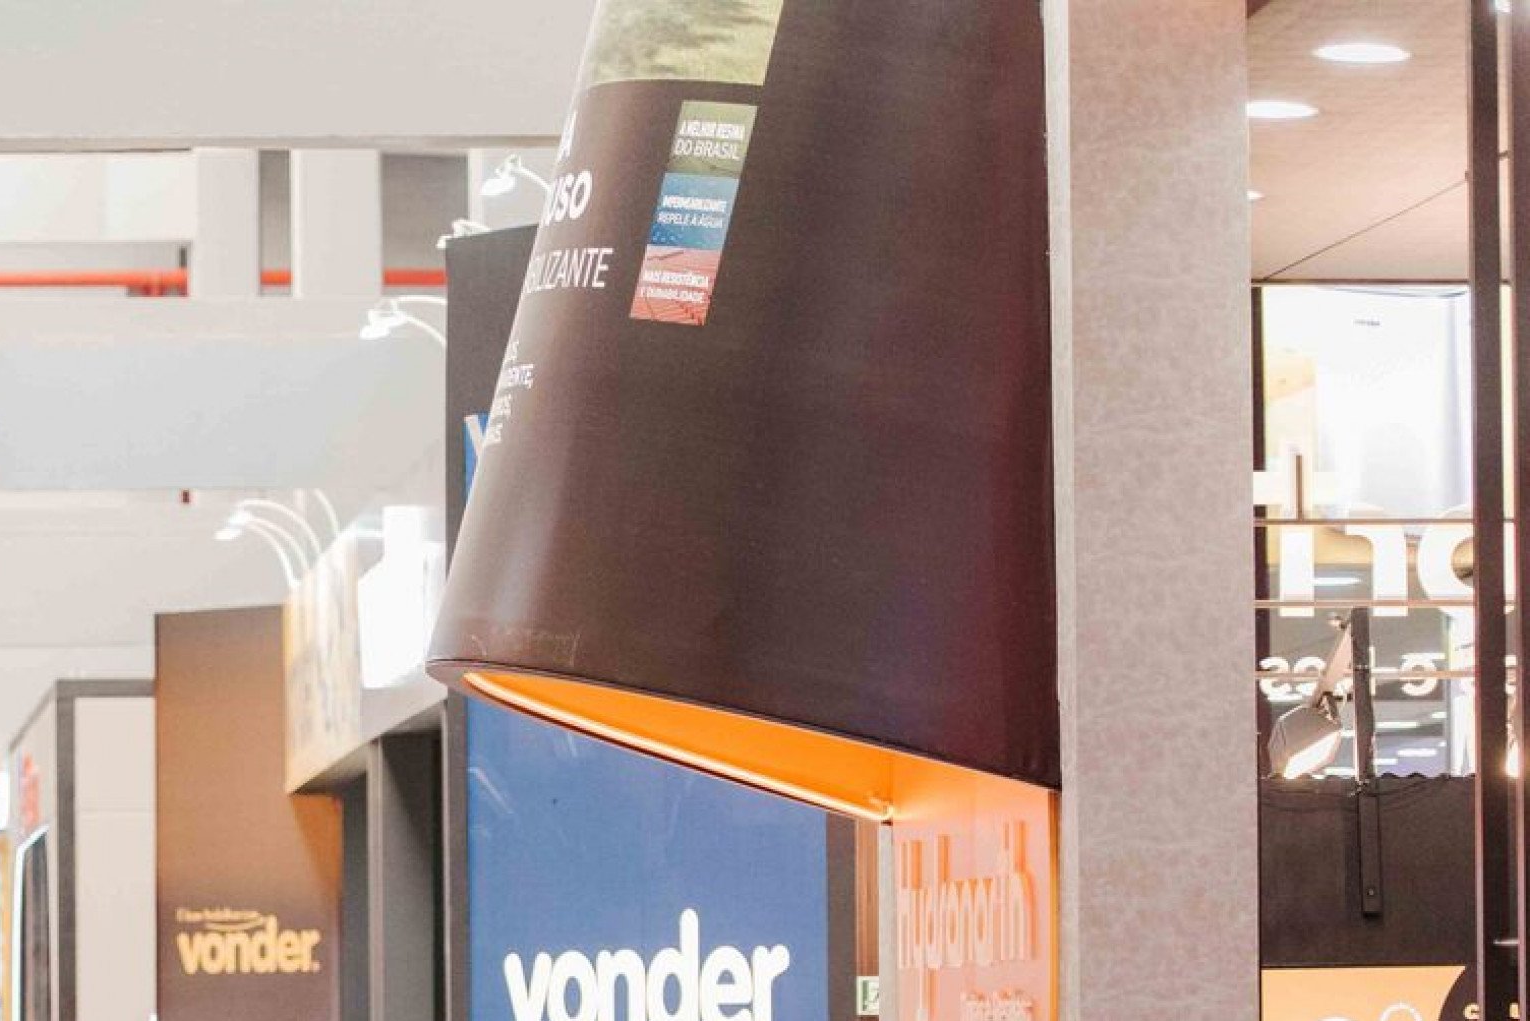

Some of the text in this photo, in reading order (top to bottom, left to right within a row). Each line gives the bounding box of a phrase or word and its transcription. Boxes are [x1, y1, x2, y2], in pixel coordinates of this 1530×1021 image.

[673, 139, 741, 161] DO BRASIL
[176, 914, 321, 974] vonder
